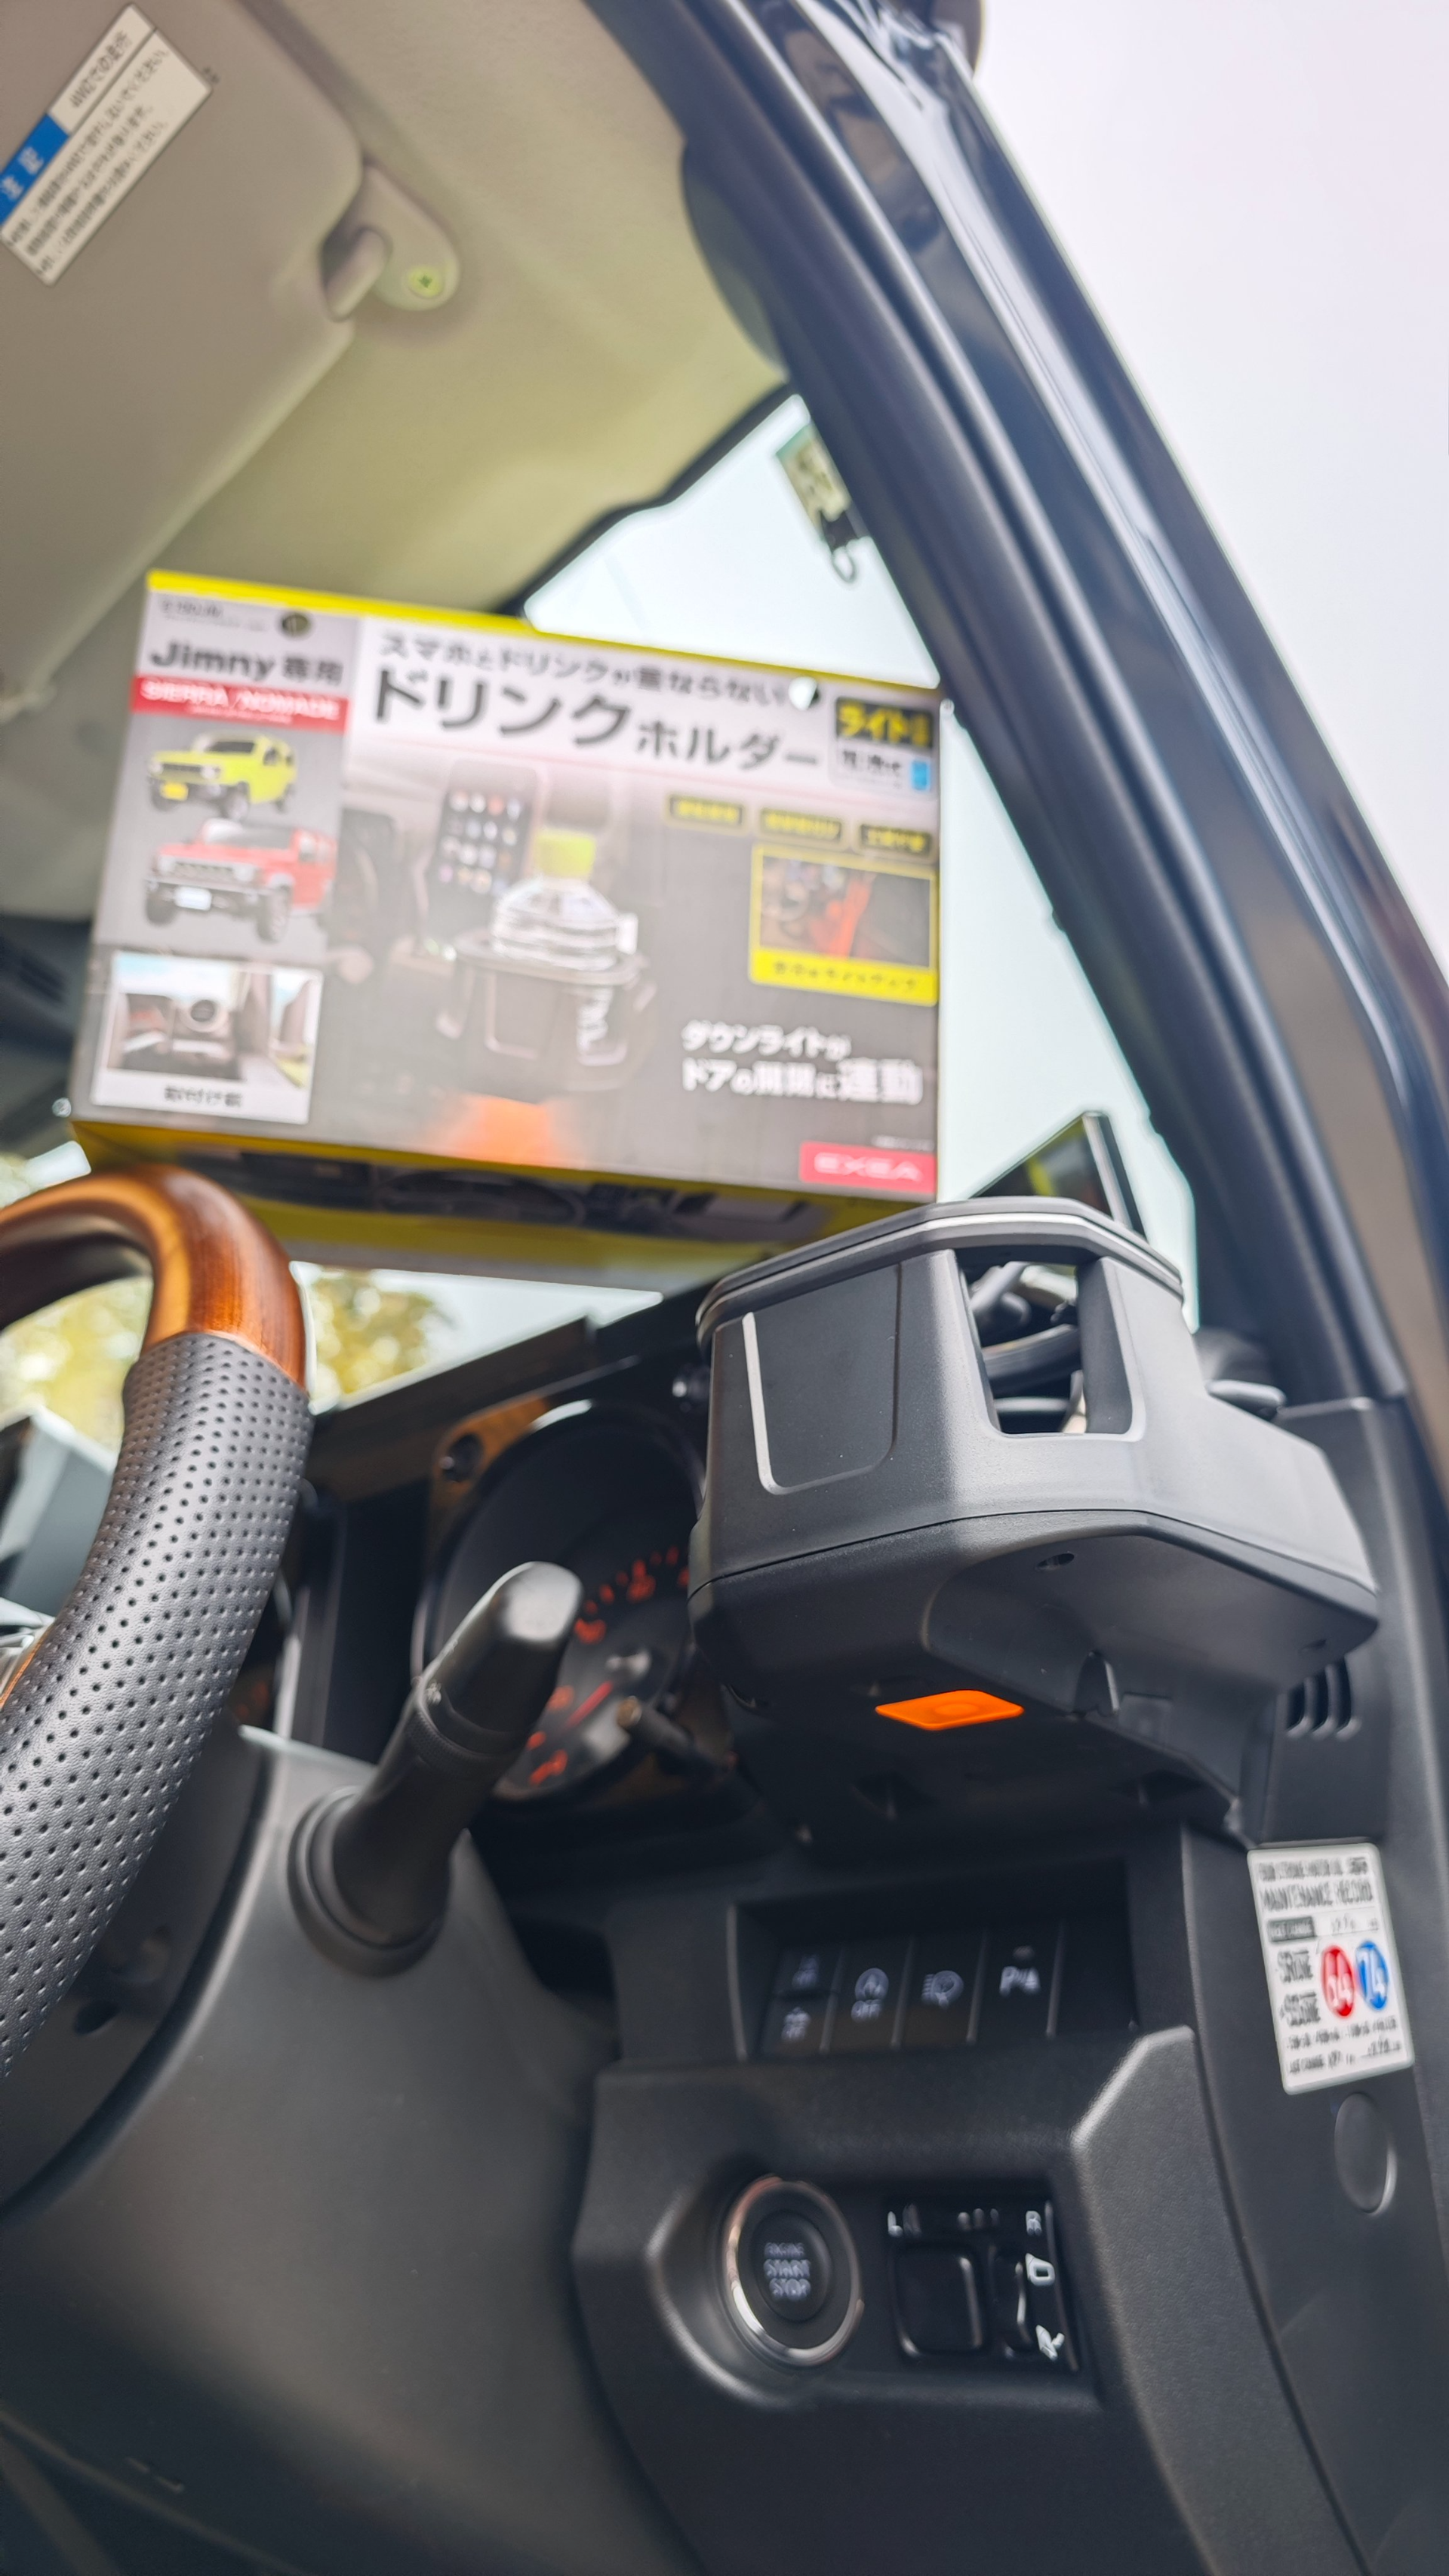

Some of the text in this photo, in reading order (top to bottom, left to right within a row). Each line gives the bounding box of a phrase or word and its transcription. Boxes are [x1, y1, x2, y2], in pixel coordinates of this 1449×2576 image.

[150, 641, 275, 682] Jimny
[376, 667, 820, 771] ドリンクホルダー
[1026, 2210, 1043, 2236] R
[763, 2259, 811, 2278] START
[769, 2278, 811, 2299] STOP
